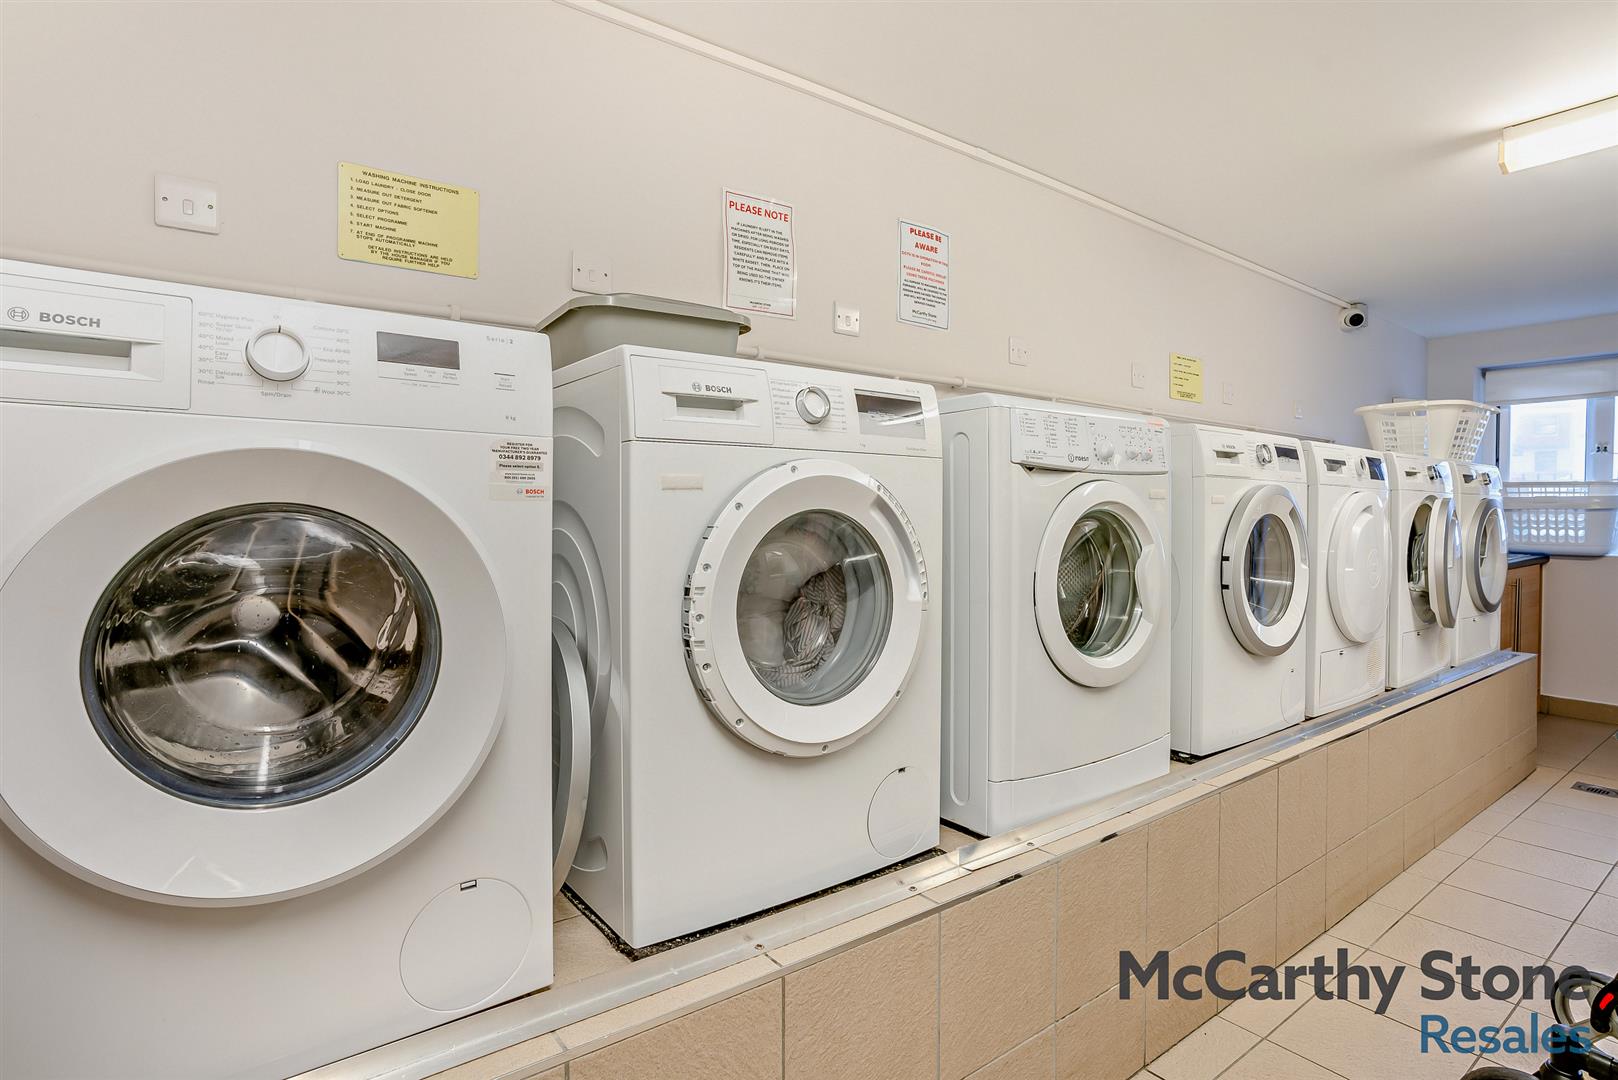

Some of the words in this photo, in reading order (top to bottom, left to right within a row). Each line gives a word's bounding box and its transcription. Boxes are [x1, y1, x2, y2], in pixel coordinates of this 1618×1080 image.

[362, 170, 389, 180] WASHING
[392, 178, 416, 186] MACHINE
[420, 183, 459, 194] INSTRUCTIONS
[394, 195, 422, 203] DETERGENT
[729, 200, 762, 216] PLEASE
[765, 209, 789, 222] NOTE
[377, 217, 407, 225] PROGRAMME
[910, 228, 934, 240] PLEASE
[935, 235, 942, 243] BE
[376, 238, 415, 247] AUTOMATICALLY
[915, 242, 938, 254] AWARE
[39, 312, 101, 328] BOSCH
[705, 385, 732, 394] BOSCH
